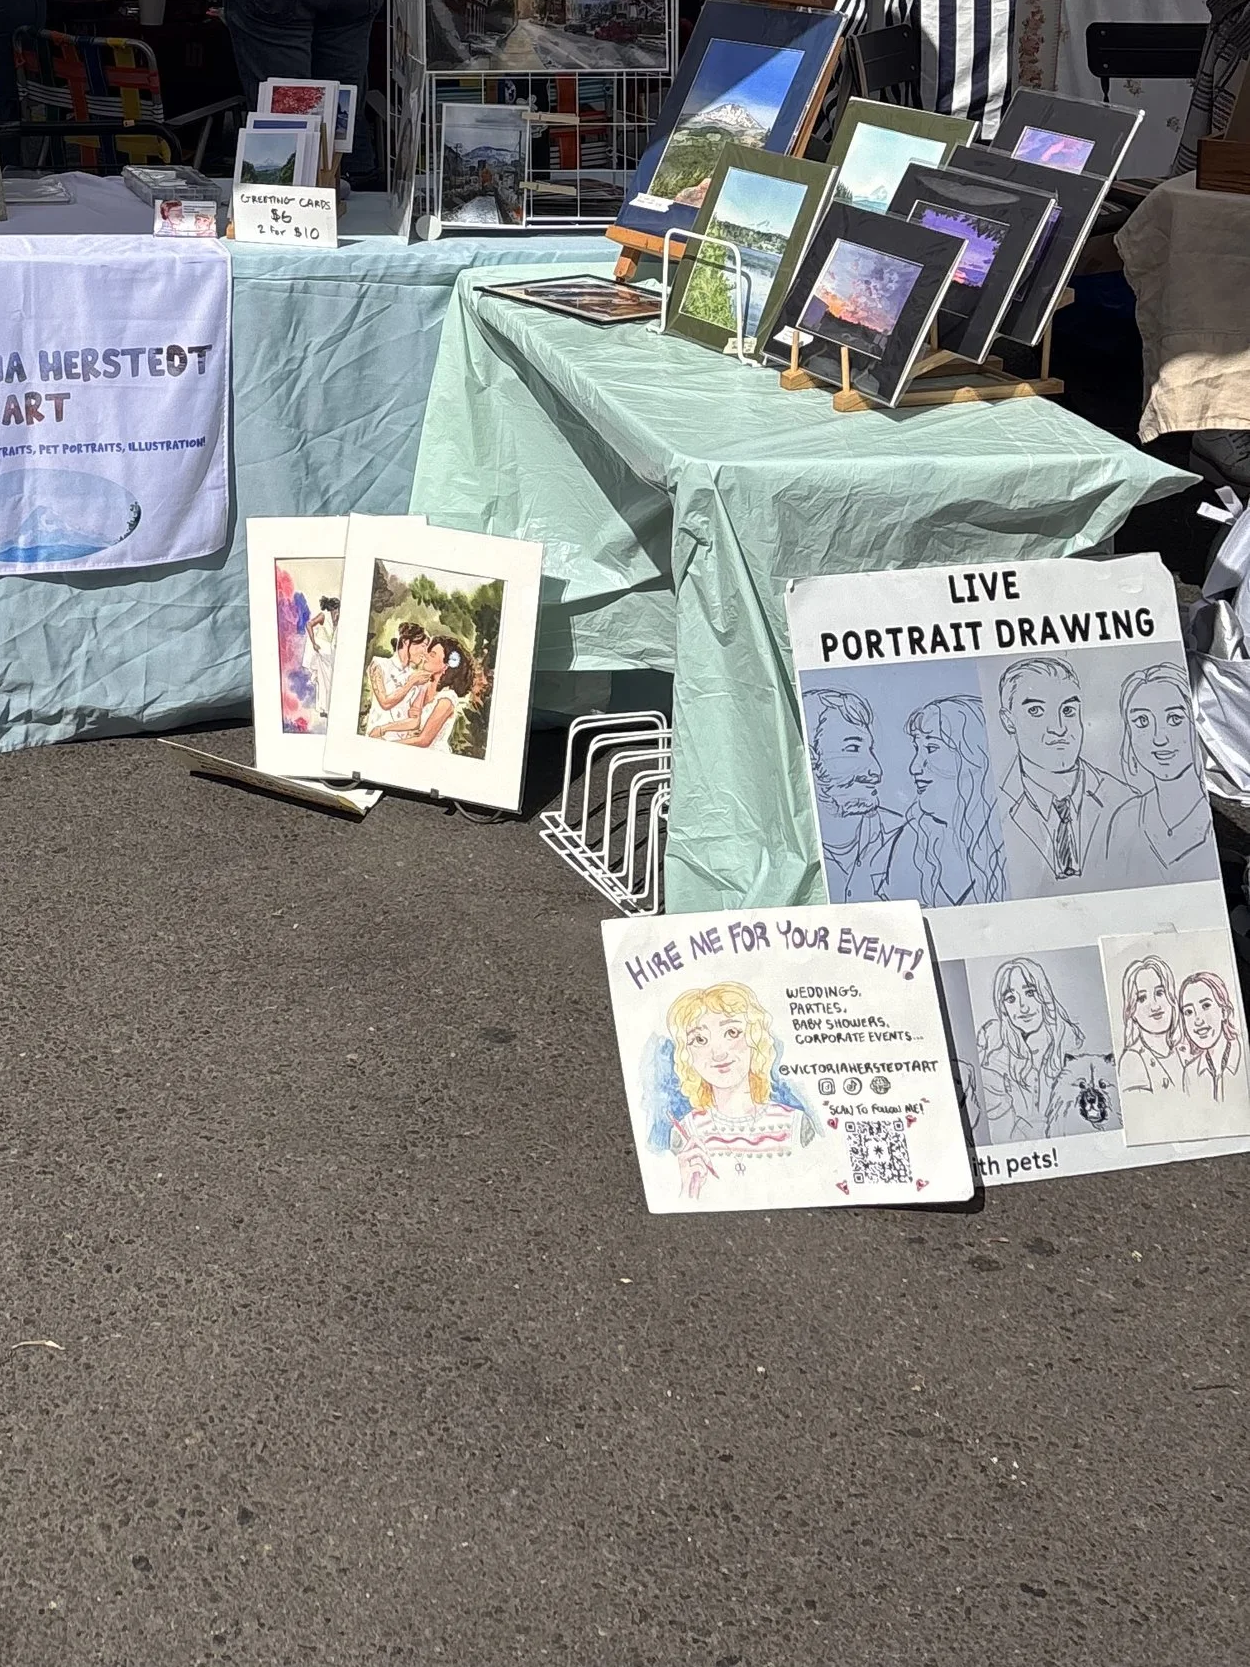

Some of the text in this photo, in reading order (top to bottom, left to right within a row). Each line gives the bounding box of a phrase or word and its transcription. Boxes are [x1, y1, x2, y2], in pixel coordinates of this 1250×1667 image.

[241, 194, 331, 210] GREETING CARDS
[271, 209, 292, 223] $6
[257, 224, 265, 234] 2
[294, 226, 319, 240] $10
[38, 344, 212, 382] HERSTEDT
[1, 391, 71, 426] ART
[39, 444, 59, 455] PET
[62, 442, 125, 455] PORTRAITS,
[128, 436, 206, 452] ILLUSTRATION!
[949, 571, 1020, 603] LIVE
[821, 608, 1155, 662] PORTRAIT DRAWING
[624, 920, 924, 990] HIRE ME FOR YOUR EVENT!
[792, 1018, 822, 1031] BABY
[795, 1032, 865, 1044] CORPORATE
[778, 1060, 938, 1076] @VICTORIAHERSTEDTART
[1006, 1147, 1059, 1178] pets!
